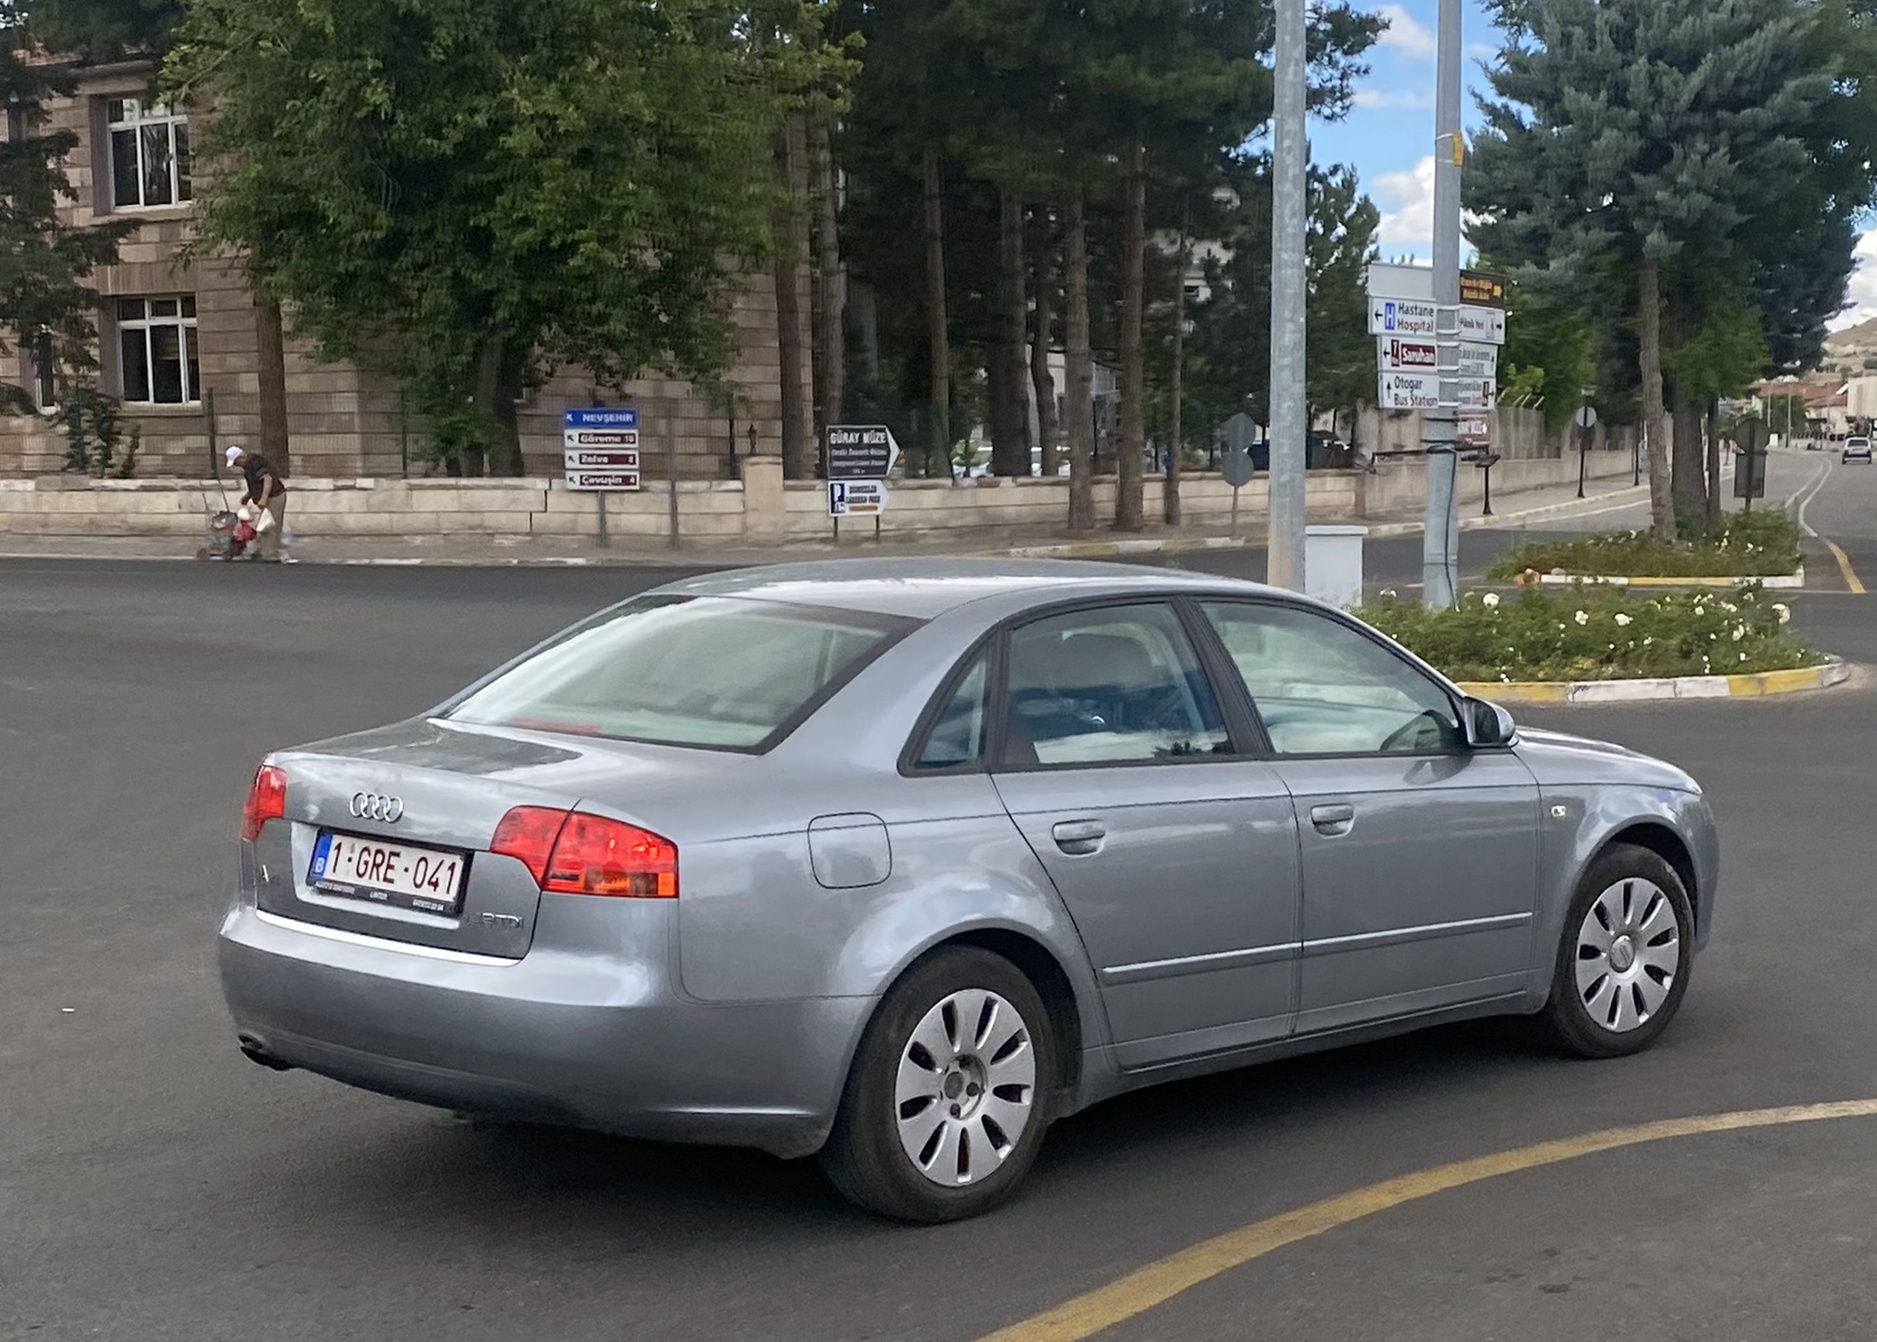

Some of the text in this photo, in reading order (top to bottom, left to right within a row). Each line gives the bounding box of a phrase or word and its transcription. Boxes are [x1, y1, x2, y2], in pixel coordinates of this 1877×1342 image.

[1398, 302, 1434, 317] Hastane
[1397, 318, 1433, 335] Hospital
[1402, 347, 1435, 362] Saruhan
[1394, 375, 1423, 393] Otogar
[1394, 393, 1438, 407] Bus Station
[582, 413, 633, 424] NEVŞEHİR
[580, 434, 622, 443] Göreme
[830, 429, 860, 444] GÜRAY
[581, 455, 609, 463] Zelve
[581, 475, 622, 486] Çavuşin
[315, 857, 325, 873] B
